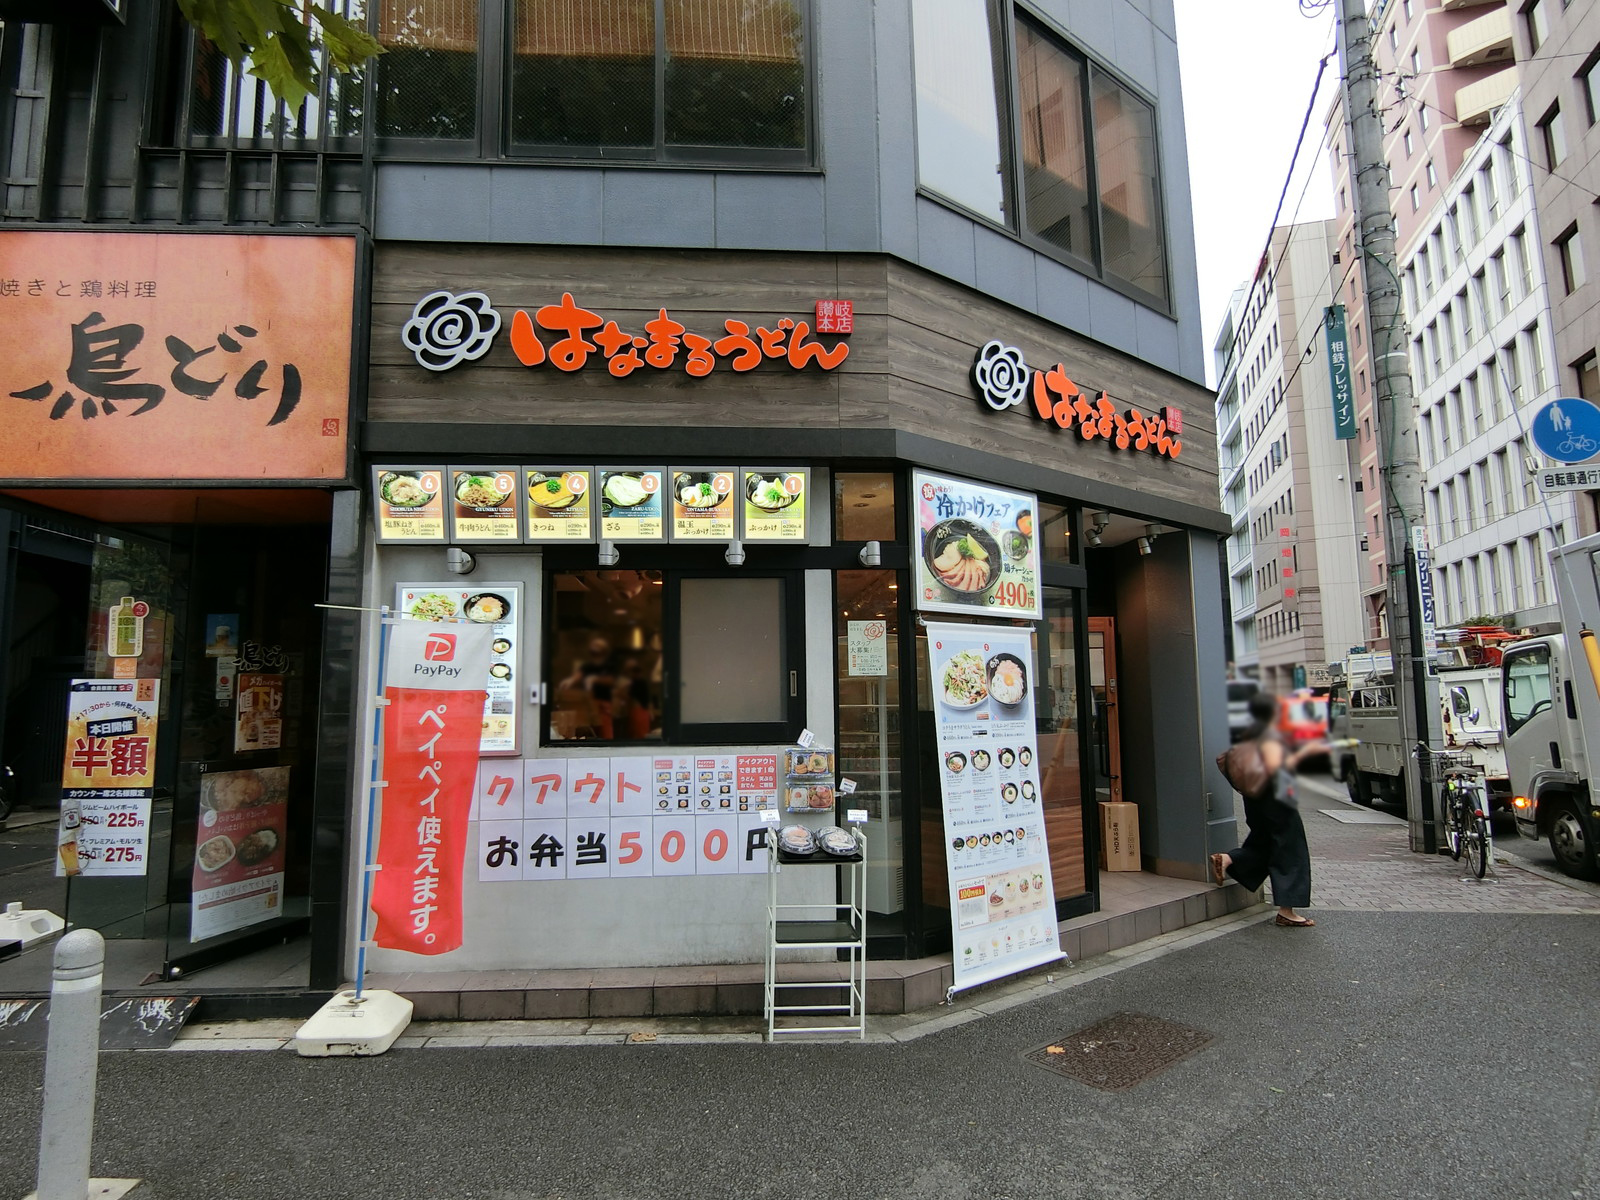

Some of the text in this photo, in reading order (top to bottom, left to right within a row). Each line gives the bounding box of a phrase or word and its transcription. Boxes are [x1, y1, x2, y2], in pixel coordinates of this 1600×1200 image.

[0, 279, 156, 297] 焼きと鶏料理
[818, 301, 851, 317] 讃岐
[818, 317, 852, 332] 本店
[511, 292, 850, 377] はなまるうどん
[9, 311, 302, 426] 鳥どり
[1331, 341, 1351, 426] 相鉄フレッサイン
[1033, 362, 1182, 459] はなまるうどん
[425, 479, 432, 489] 6
[500, 479, 507, 489] 5
[572, 479, 580, 489] 4
[645, 479, 653, 489] 3
[718, 479, 725, 490] 2
[790, 480, 796, 490] 1
[1544, 470, 1600, 487] 自転車通行
[936, 493, 1011, 518] 冷かけフェア
[533, 523, 555, 531] きつね
[606, 522, 621, 531] ざる
[749, 524, 777, 532] ぶっかけ
[414, 664, 462, 678] PayPay
[90, 721, 134, 735] 本日開催
[72, 736, 150, 777] 半額
[107, 812, 144, 828] 225円
[410, 704, 447, 944] ペイペイ使えます。
[105, 847, 142, 862] 275円
[486, 827, 768, 867] お弁当500円
